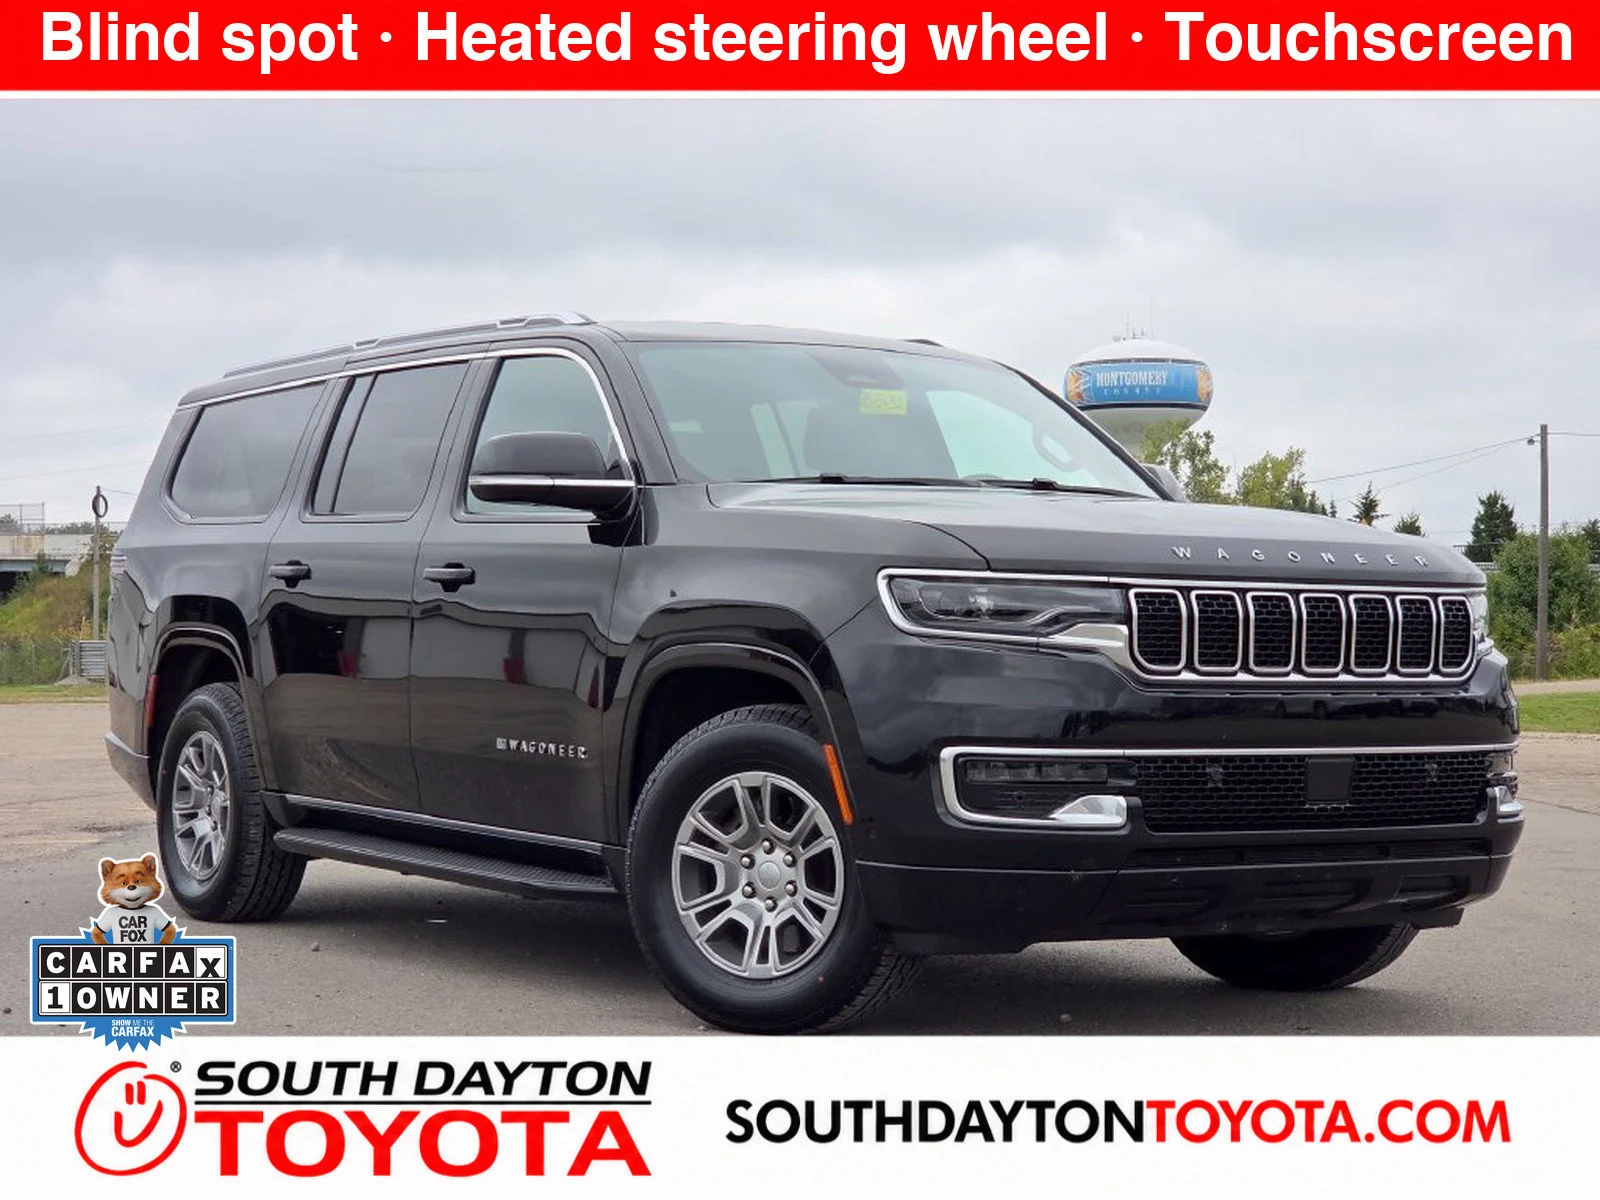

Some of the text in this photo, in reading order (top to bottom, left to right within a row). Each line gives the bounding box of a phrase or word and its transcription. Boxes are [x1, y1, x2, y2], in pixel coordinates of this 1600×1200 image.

[1096, 370, 1168, 387] MONTGOMERY
[1172, 545, 1429, 567] WAGONEER
[508, 739, 588, 759] WAGONEER
